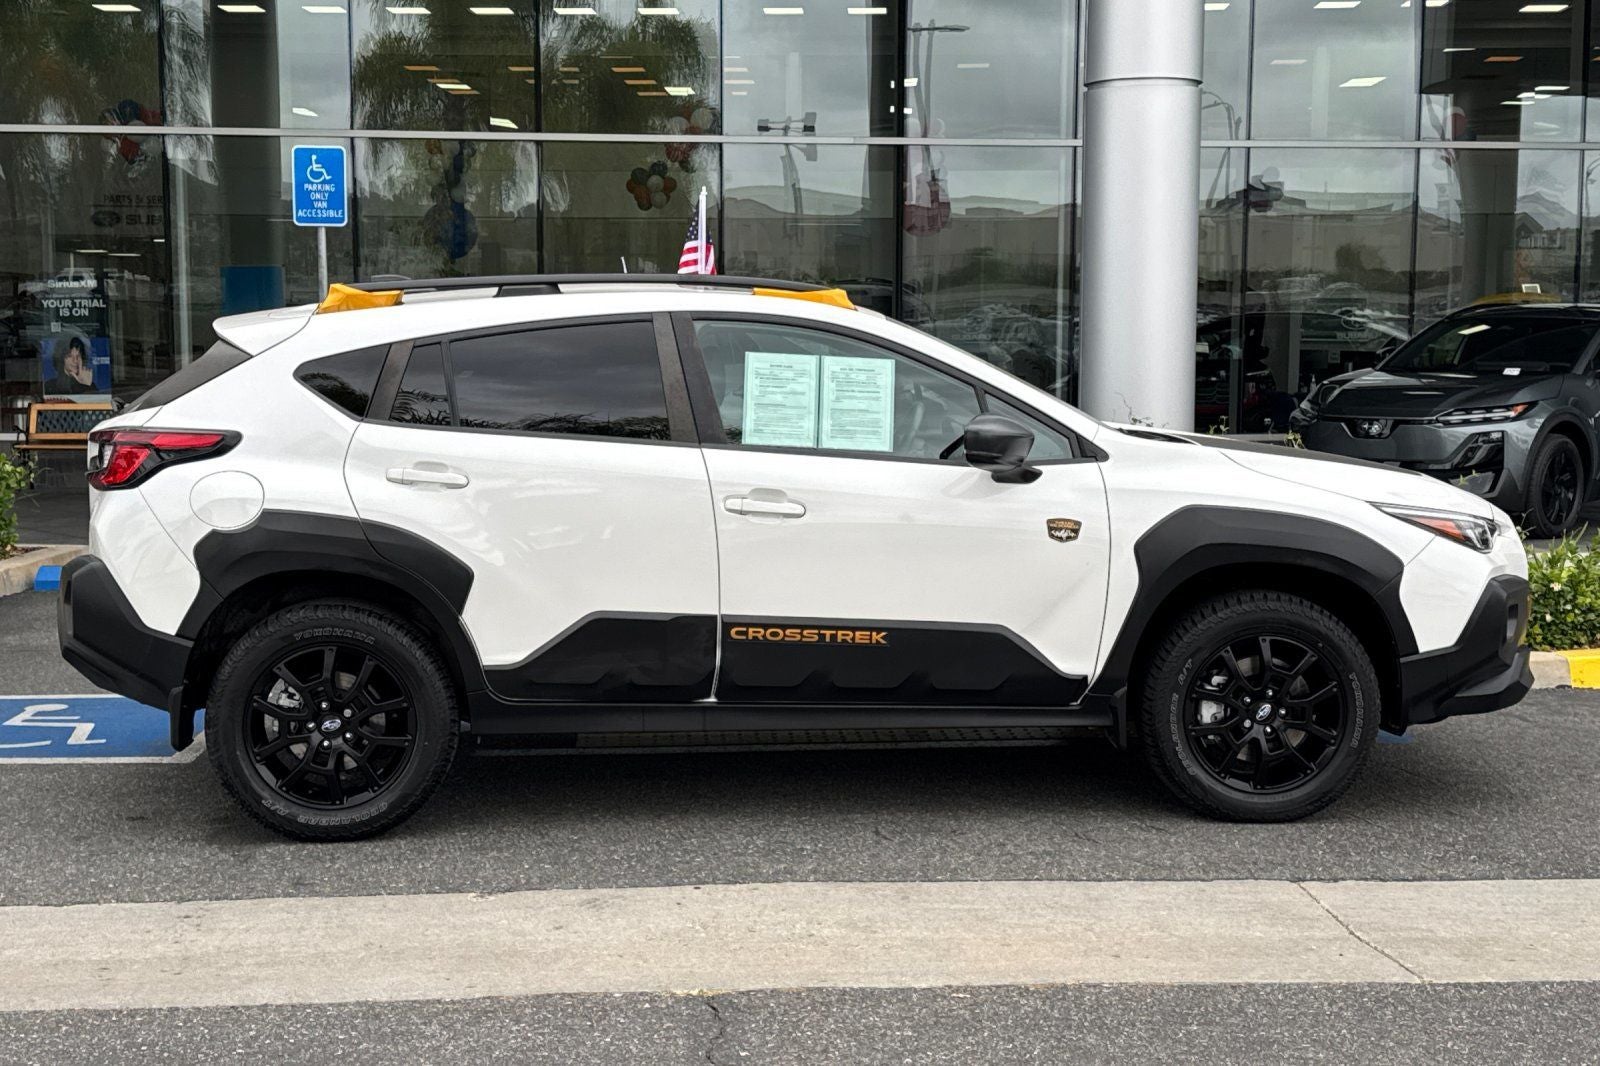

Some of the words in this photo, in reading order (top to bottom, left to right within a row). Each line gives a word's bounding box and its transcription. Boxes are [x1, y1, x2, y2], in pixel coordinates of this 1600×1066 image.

[304, 183, 335, 192] PARKING
[104, 194, 132, 204] PARTS
[310, 192, 329, 200] ONLY
[313, 201, 328, 209] VAN
[297, 209, 344, 218] ACCESSIBLE
[47, 279, 98, 288] SiriusXM
[41, 299, 72, 308] YOUR
[74, 299, 106, 308] TRIAL
[59, 308, 70, 317] IS
[72, 308, 89, 317] ON
[293, 627, 376, 645] YOKOHAMA
[730, 627, 889, 645] CROSSTREK
[1177, 658, 1193, 686] A/T
[1349, 671, 1364, 749] YOKOHAMA
